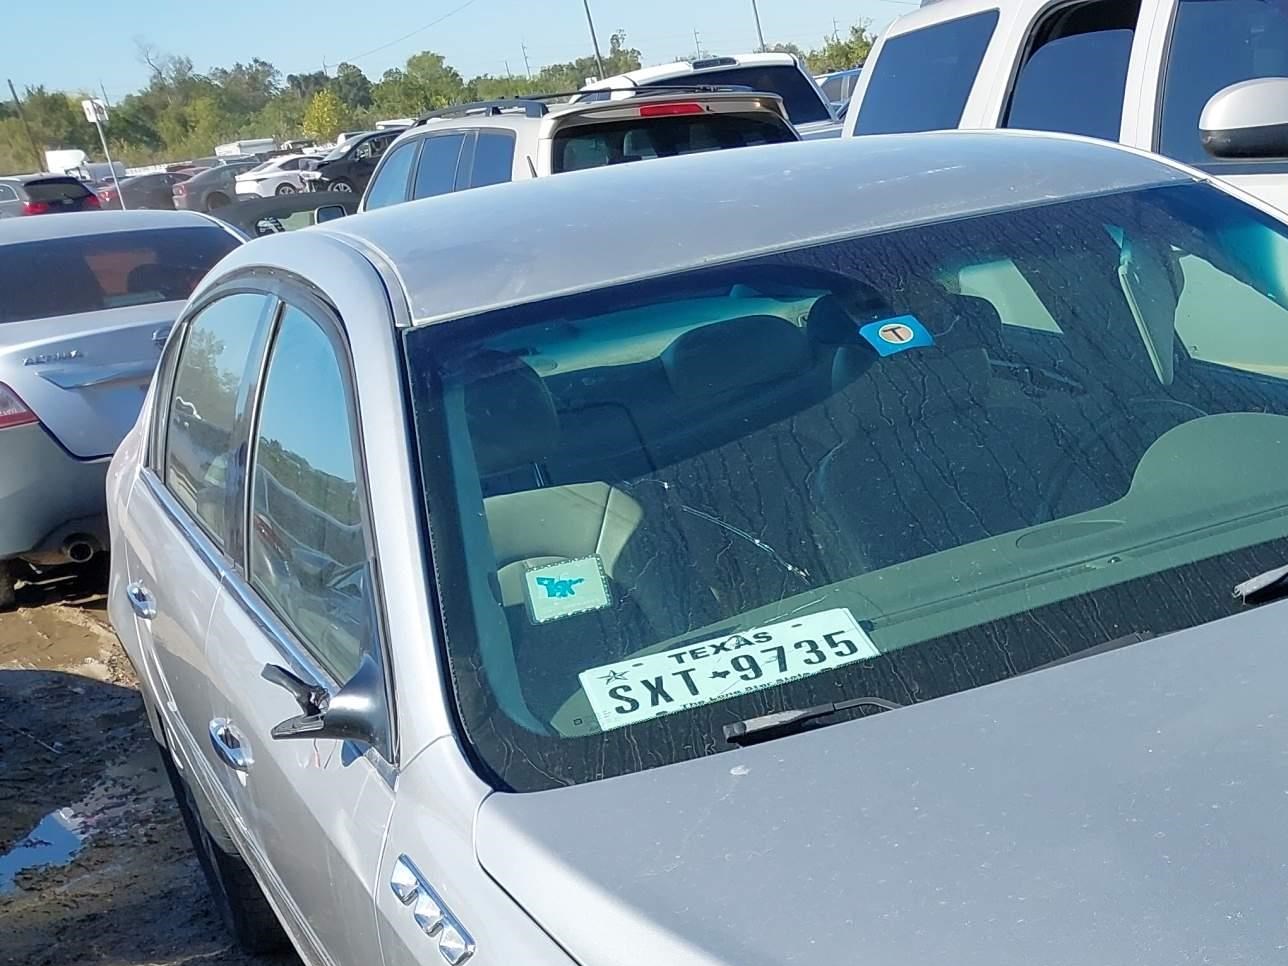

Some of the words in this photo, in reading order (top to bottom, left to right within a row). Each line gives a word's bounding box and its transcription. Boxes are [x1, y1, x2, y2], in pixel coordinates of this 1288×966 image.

[608, 667, 700, 715] SXT
[730, 630, 859, 682] 9735
[667, 631, 773, 665] TEXAS
